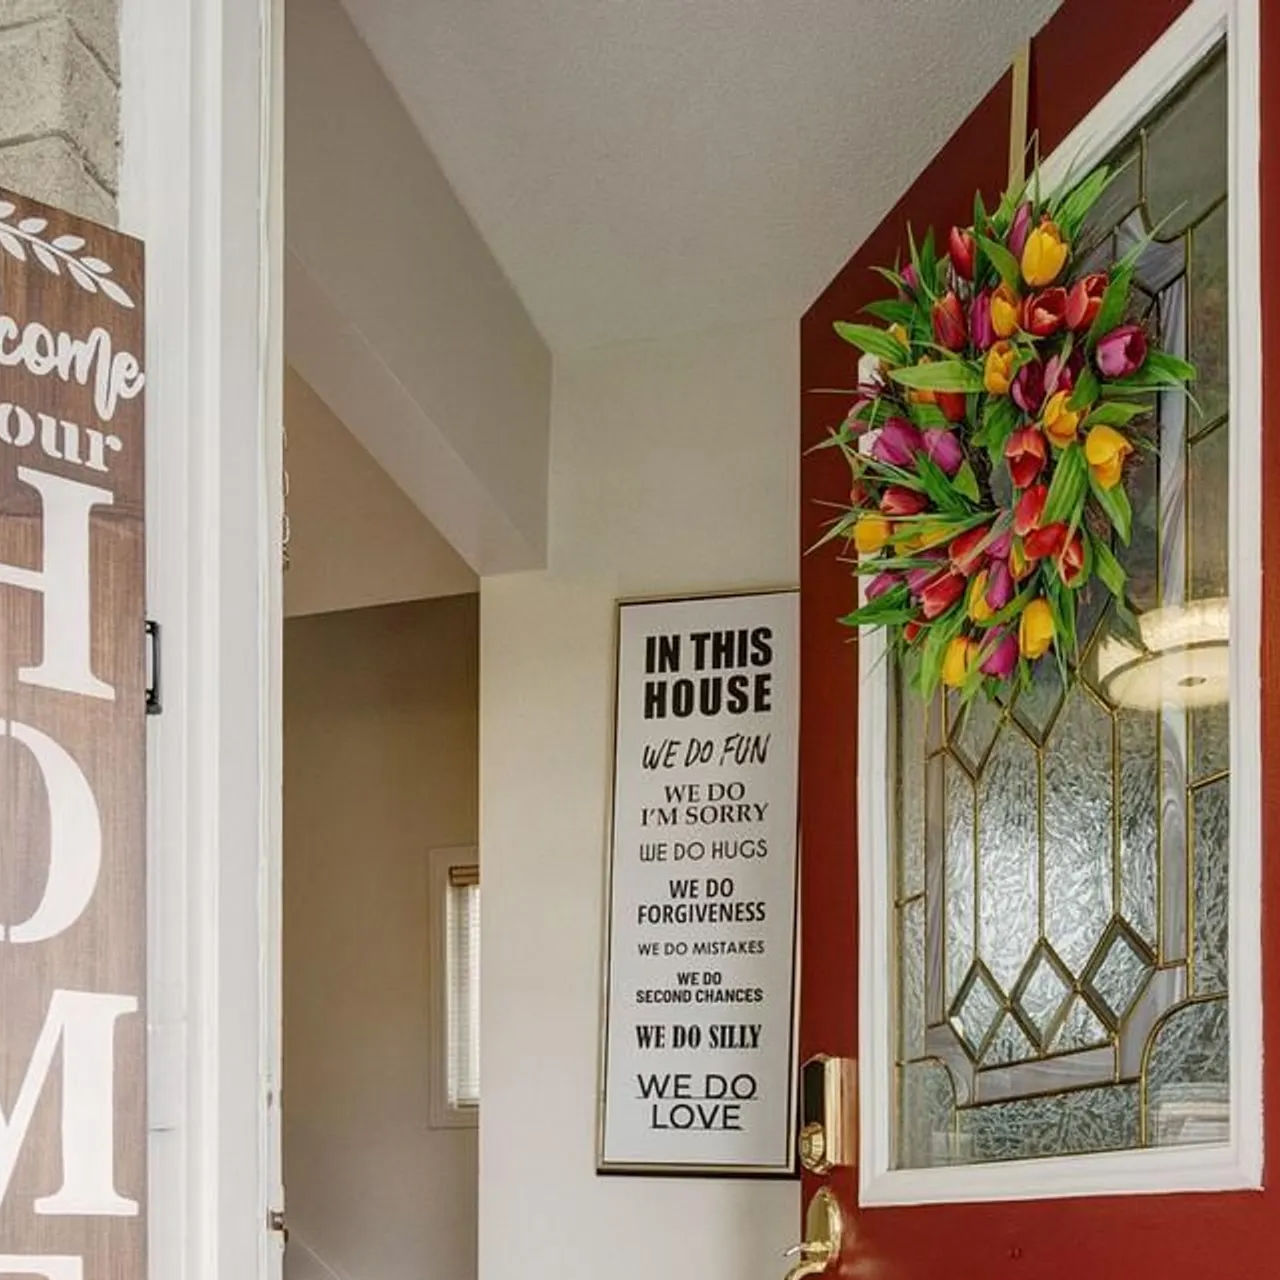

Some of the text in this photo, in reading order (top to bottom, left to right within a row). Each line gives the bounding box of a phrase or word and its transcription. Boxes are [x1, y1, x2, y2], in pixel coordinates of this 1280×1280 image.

[645, 627, 773, 673] IN THIS
[644, 673, 771, 719] HOUSE
[642, 732, 771, 770] WE DO FUN
[664, 781, 746, 803] WE DO
[641, 802, 769, 827] I'M SORRY
[639, 839, 768, 862] WE DO HUGS
[669, 878, 734, 899] WE DO
[637, 901, 766, 925] FORGIVENESS
[637, 940, 765, 956] WE DO MISTAKES
[677, 971, 722, 986] WE DO
[636, 988, 764, 1004] SECOND CHANCES
[635, 1024, 762, 1049] WE DO SILLY
[637, 1074, 757, 1099] WE DO
[652, 1104, 741, 1129] LOVE
